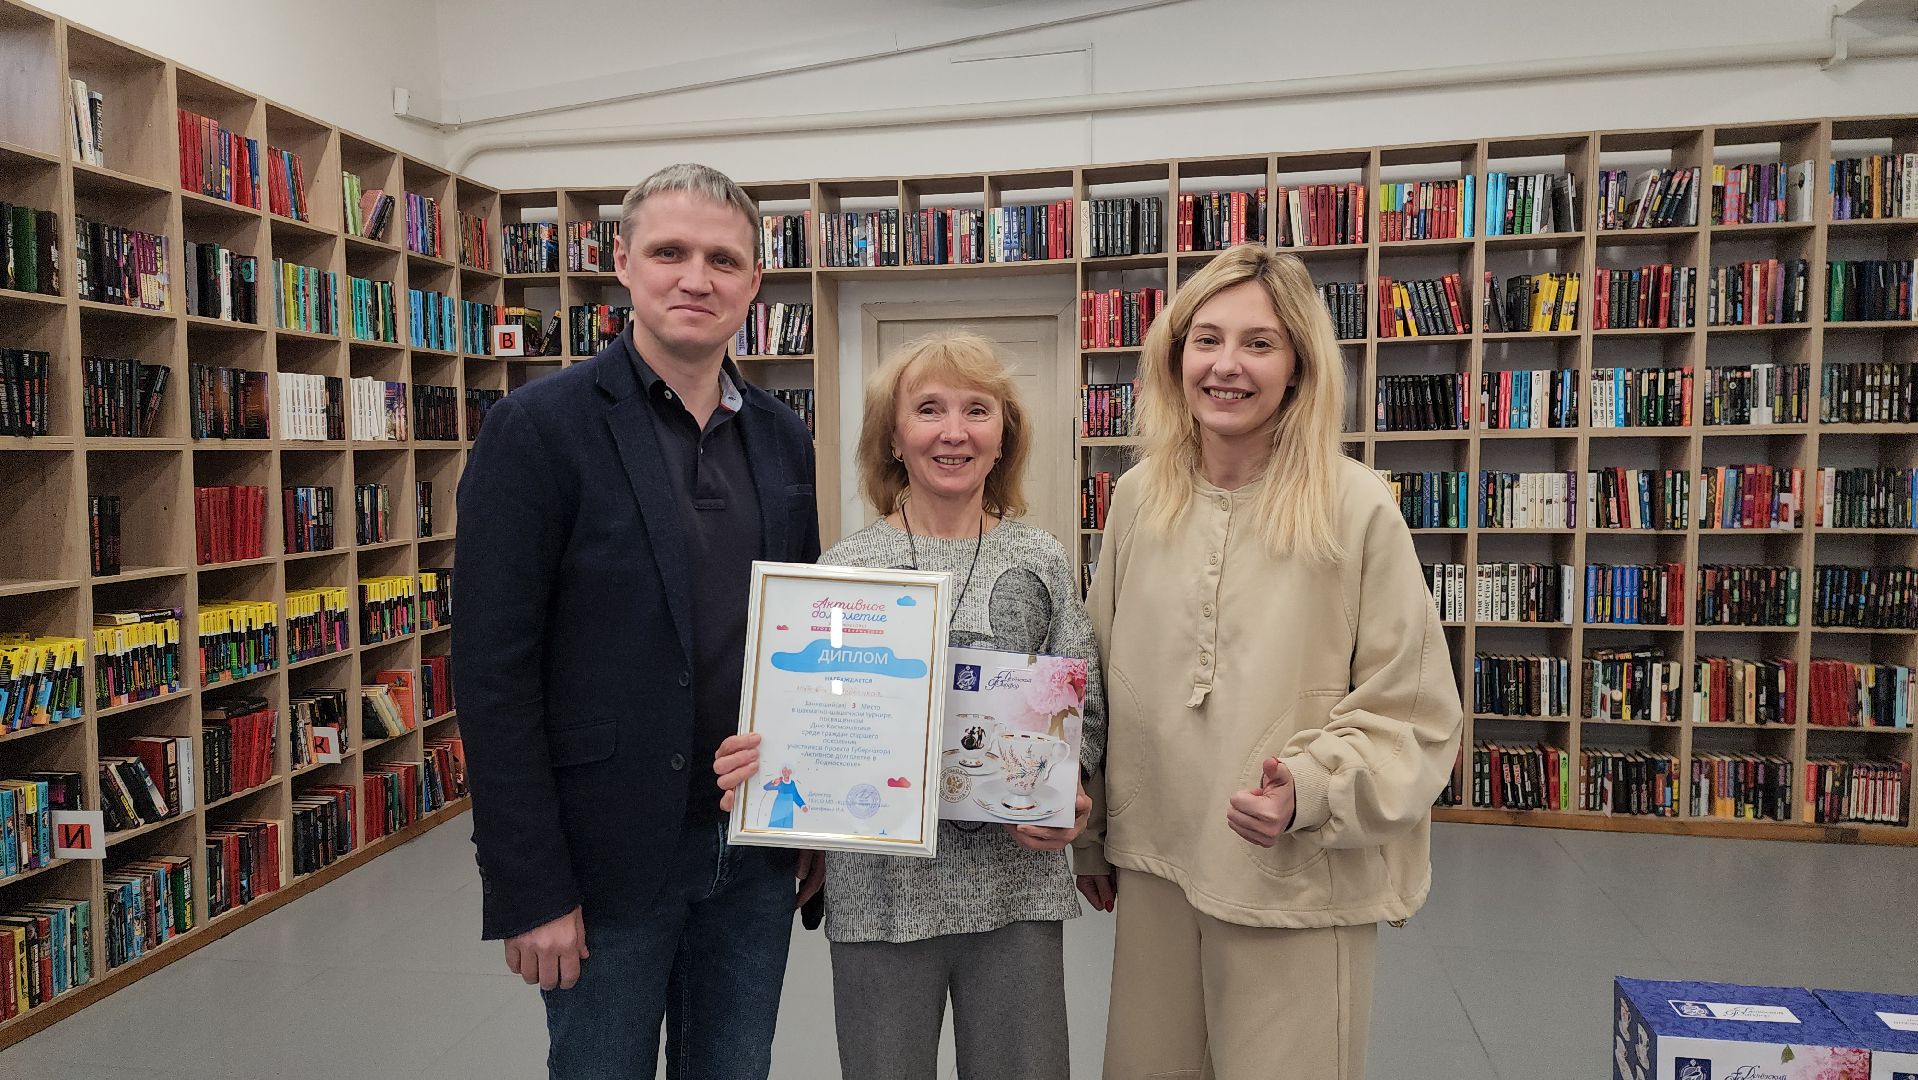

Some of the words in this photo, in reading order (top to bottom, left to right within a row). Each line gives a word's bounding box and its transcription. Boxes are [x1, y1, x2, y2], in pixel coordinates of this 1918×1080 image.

[590, 248, 597, 264] Б
[502, 332, 514, 349] В
[812, 597, 886, 612] Активное
[811, 606, 888, 622] дололетие
[817, 649, 889, 665] ДИПЛОМ
[314, 736, 327, 754] К
[64, 824, 87, 849] И
